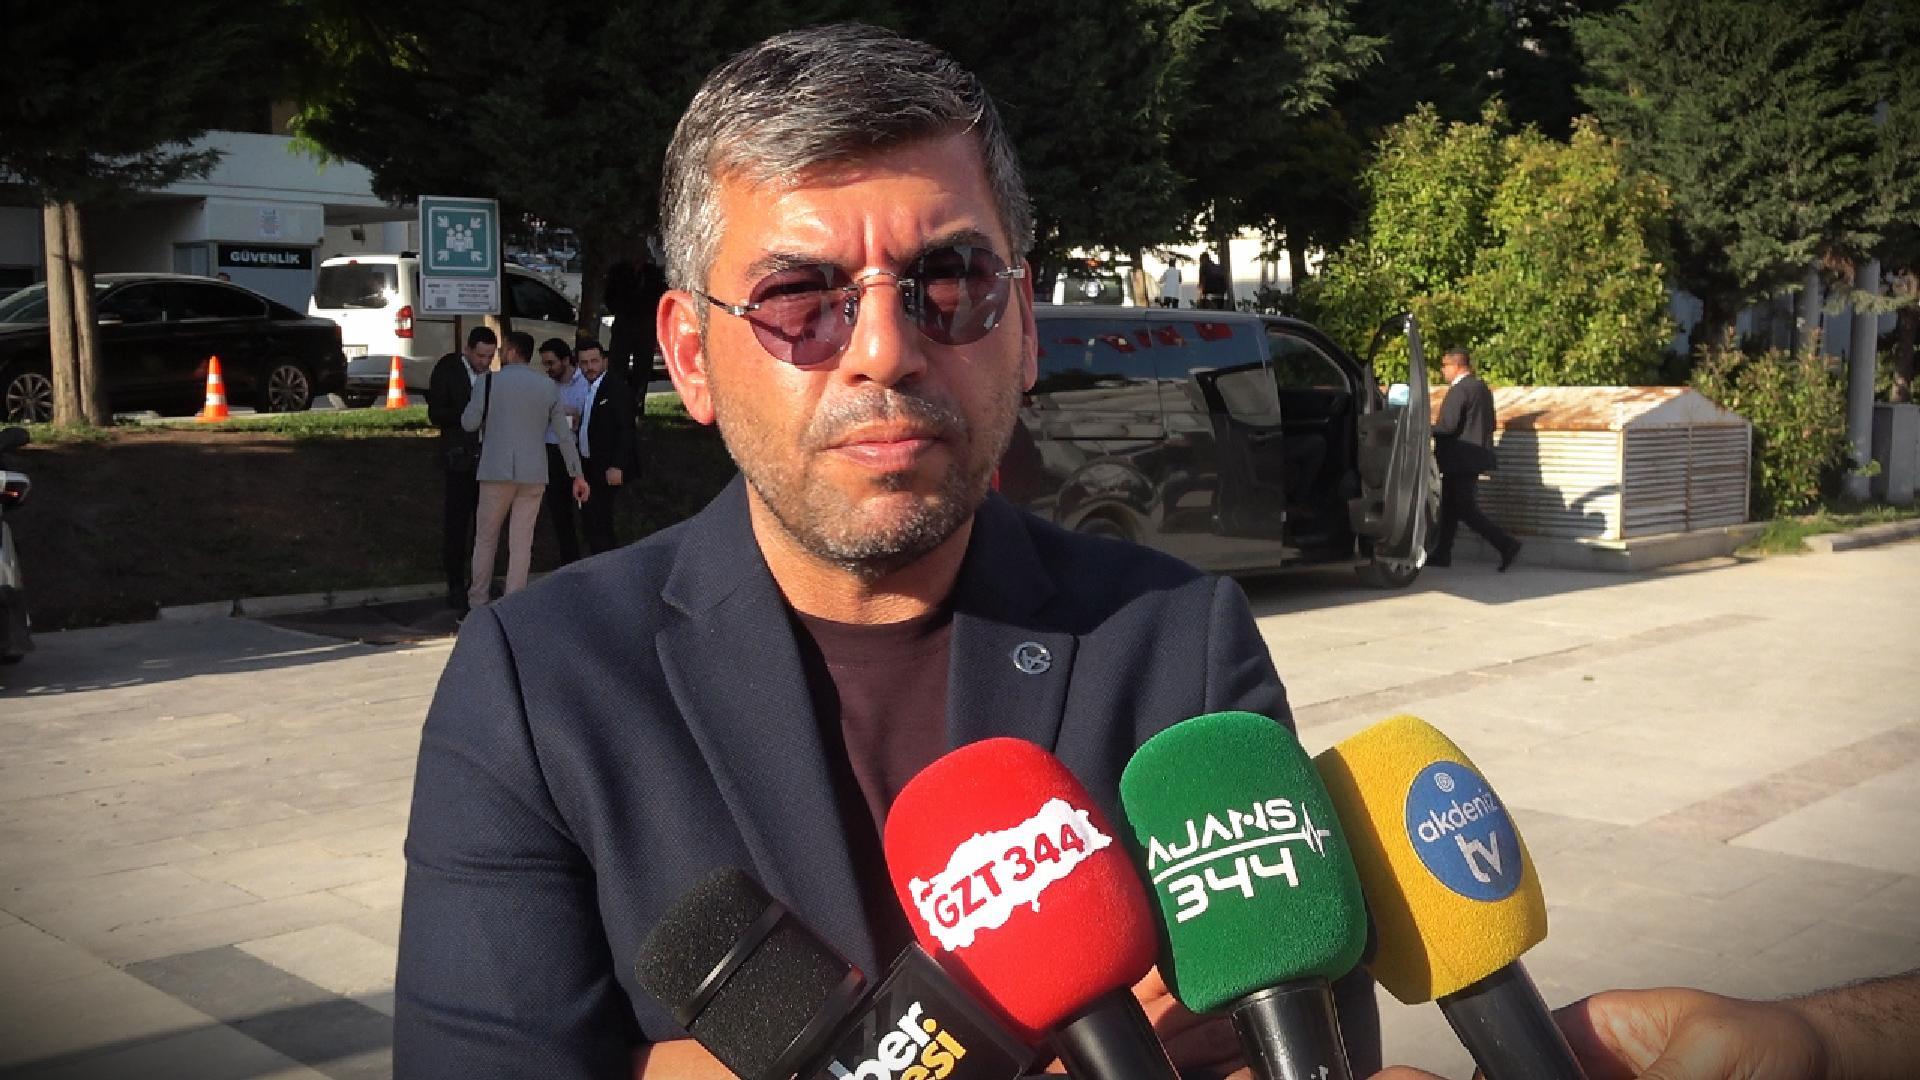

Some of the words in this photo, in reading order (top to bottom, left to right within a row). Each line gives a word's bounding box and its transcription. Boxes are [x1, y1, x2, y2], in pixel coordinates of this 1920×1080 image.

[230, 250, 300, 264] GÜVENLİK
[1148, 797, 1298, 870] AJANS
[1418, 788, 1498, 842] akdeniz
[934, 861, 1003, 928] GZT
[1003, 824, 1085, 882] 344
[1168, 848, 1299, 923] 344
[1454, 830, 1502, 882] tv
